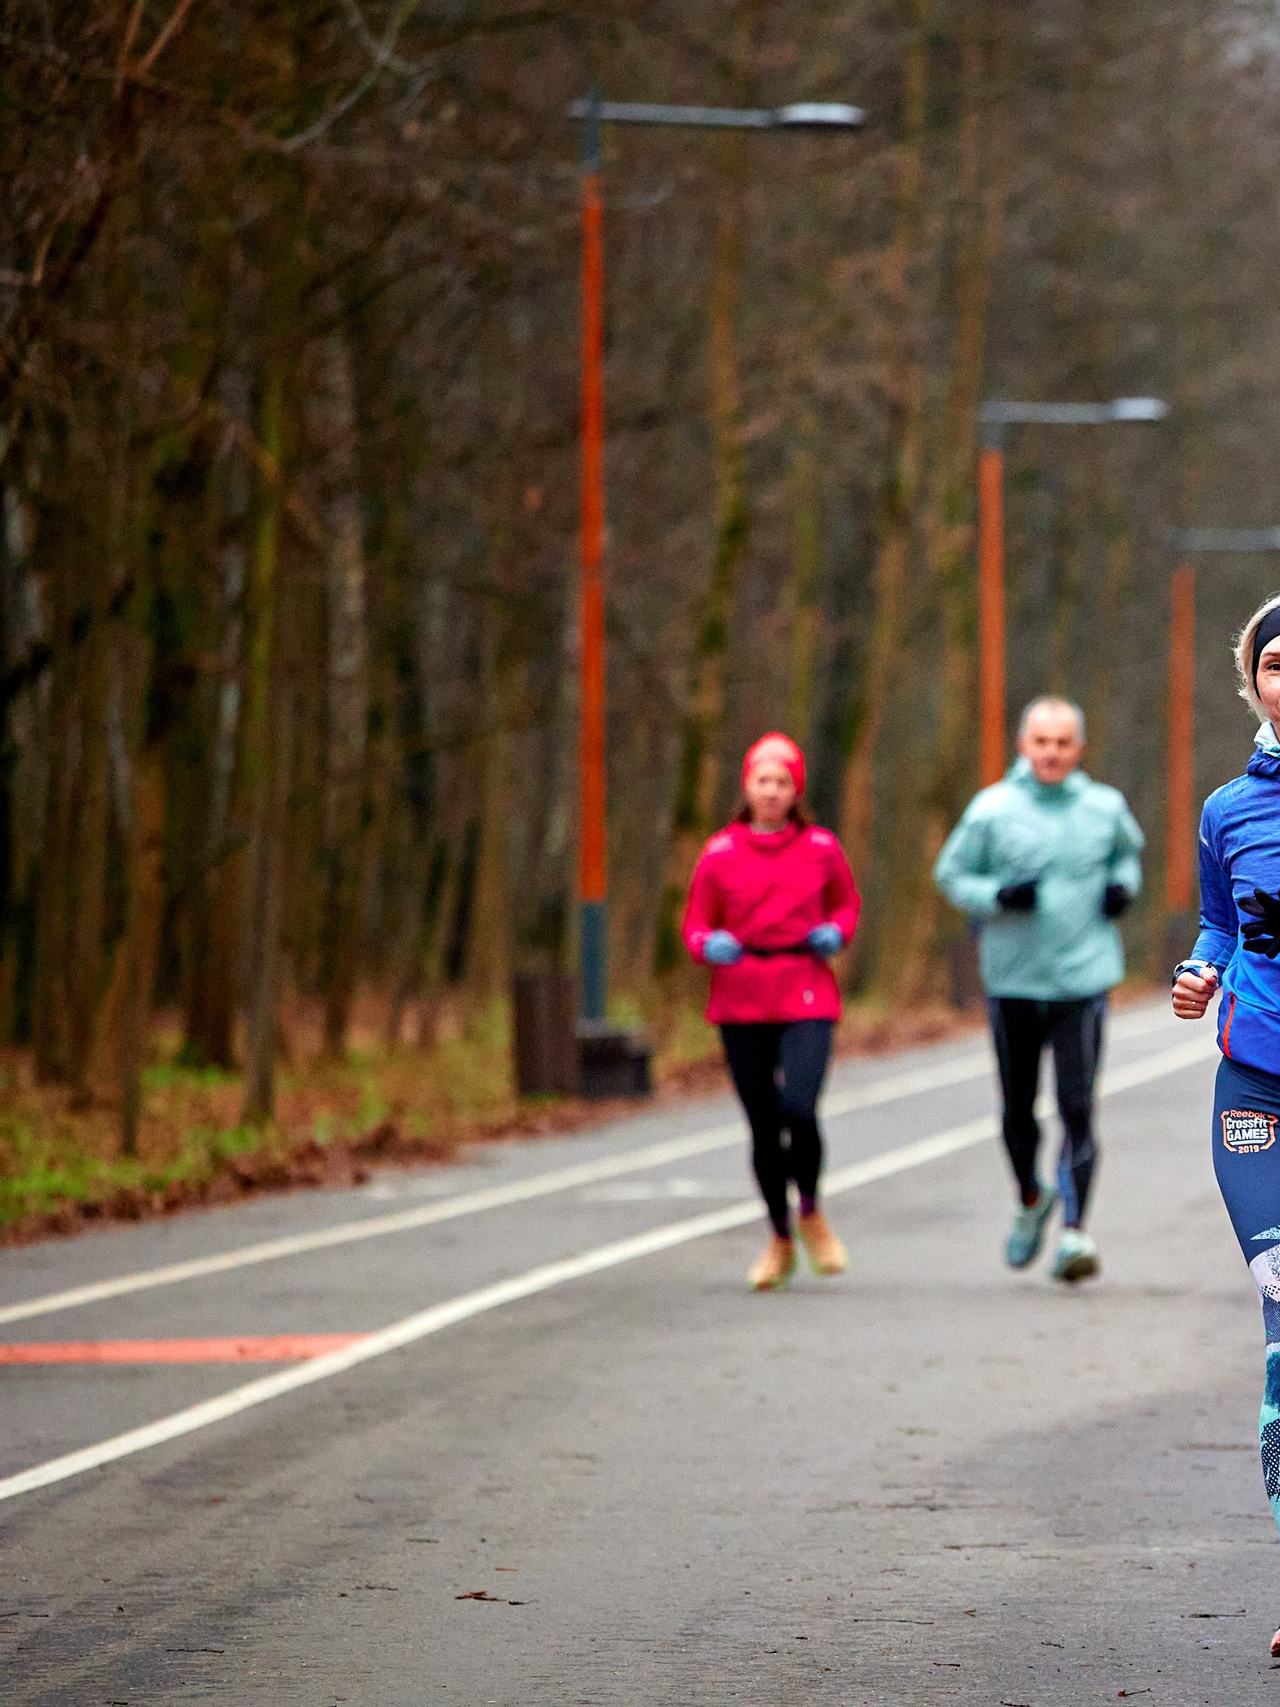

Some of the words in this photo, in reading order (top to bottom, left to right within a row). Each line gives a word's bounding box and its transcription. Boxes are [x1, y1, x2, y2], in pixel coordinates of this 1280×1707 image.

[1230, 1109, 1266, 1119] Reebok
[1226, 1117, 1268, 1130] CrossFit
[1226, 1128, 1268, 1142] GAMES
[1238, 1145, 1260, 1154] 2019
